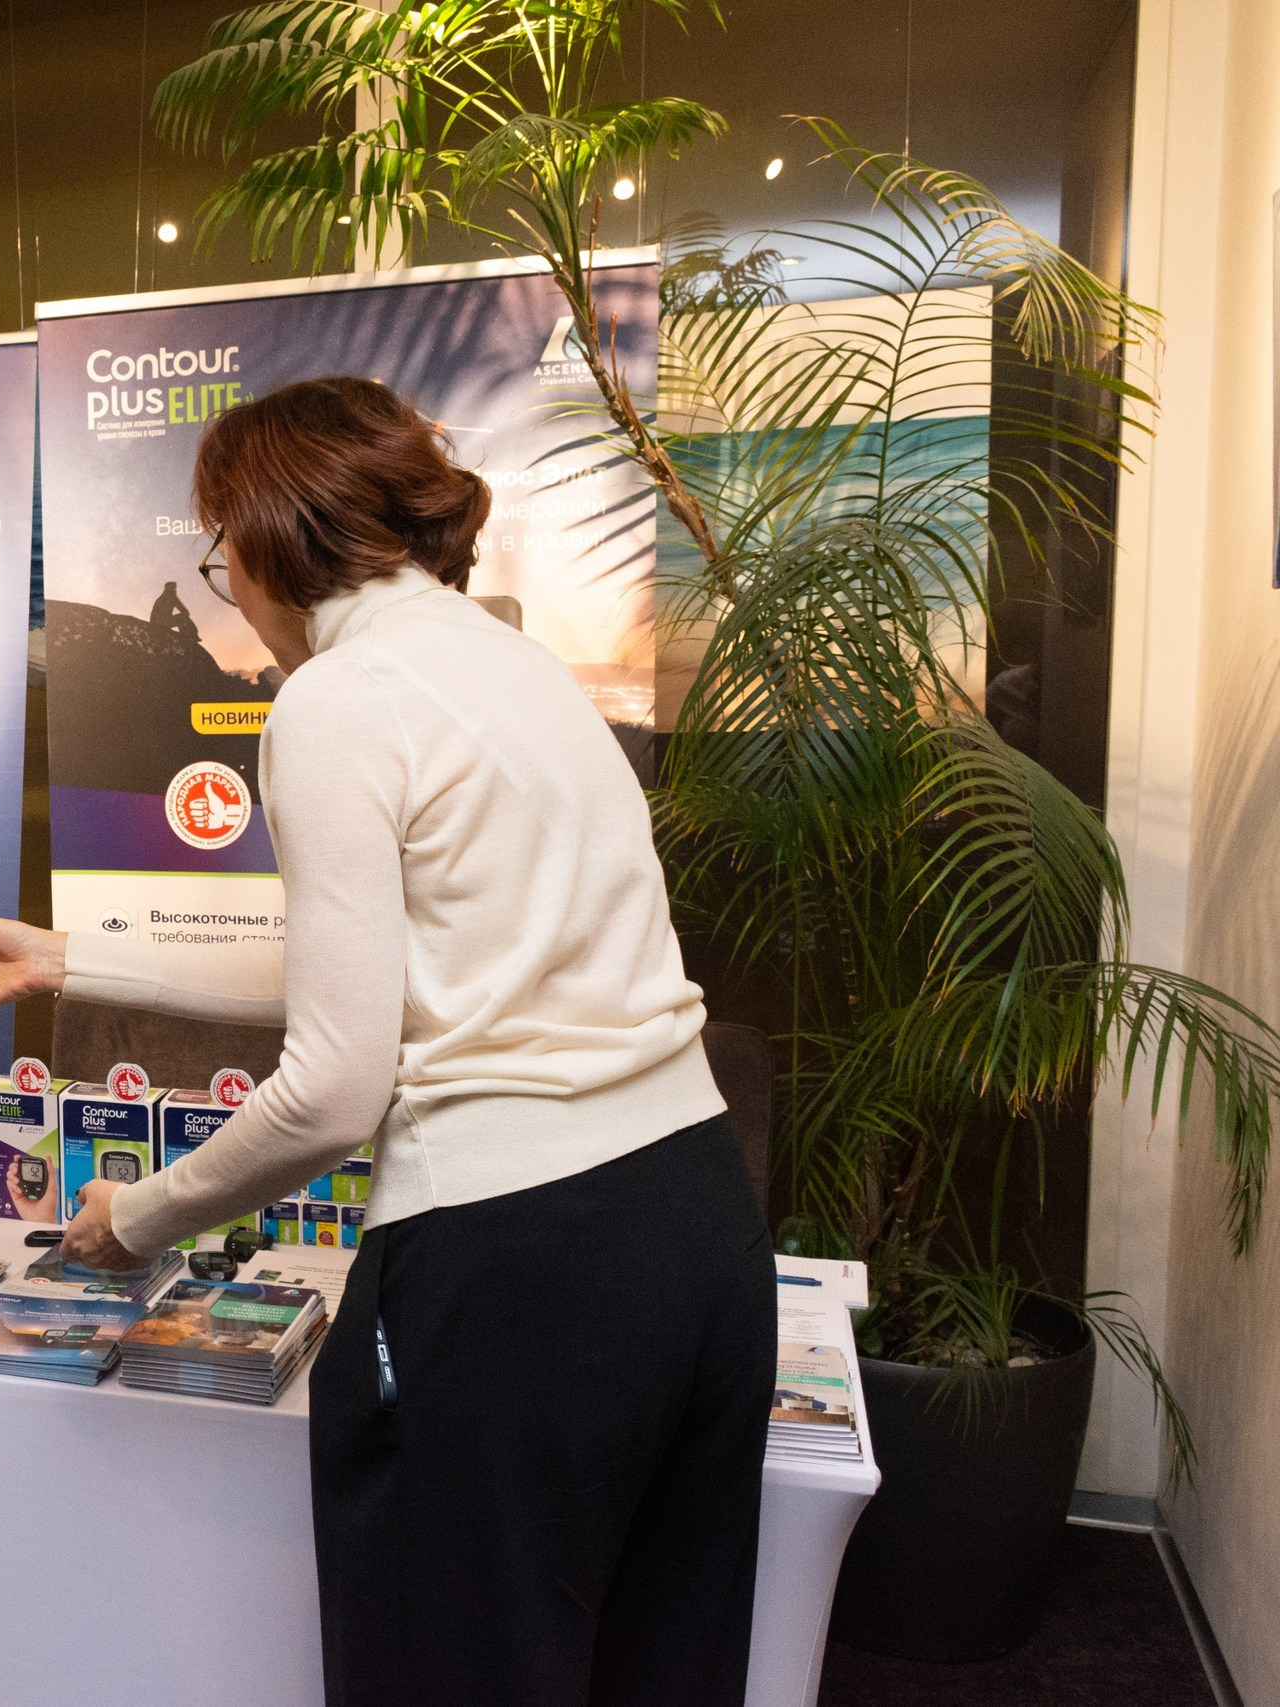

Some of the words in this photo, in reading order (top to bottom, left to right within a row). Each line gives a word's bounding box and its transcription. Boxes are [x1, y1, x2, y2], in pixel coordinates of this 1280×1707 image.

[533, 362, 589, 378] ASCENS
[87, 385, 165, 430] plus
[177, 773, 203, 827] НАРОДНАЯ
[205, 772, 237, 798] МАРКА
[150, 909, 269, 928] Высокоточные
[150, 930, 238, 944] требования
[2, 1105, 22, 1117] ELITE
[82, 1105, 128, 1119] Contour
[82, 1115, 107, 1128] plus
[184, 1124, 210, 1136] plus
